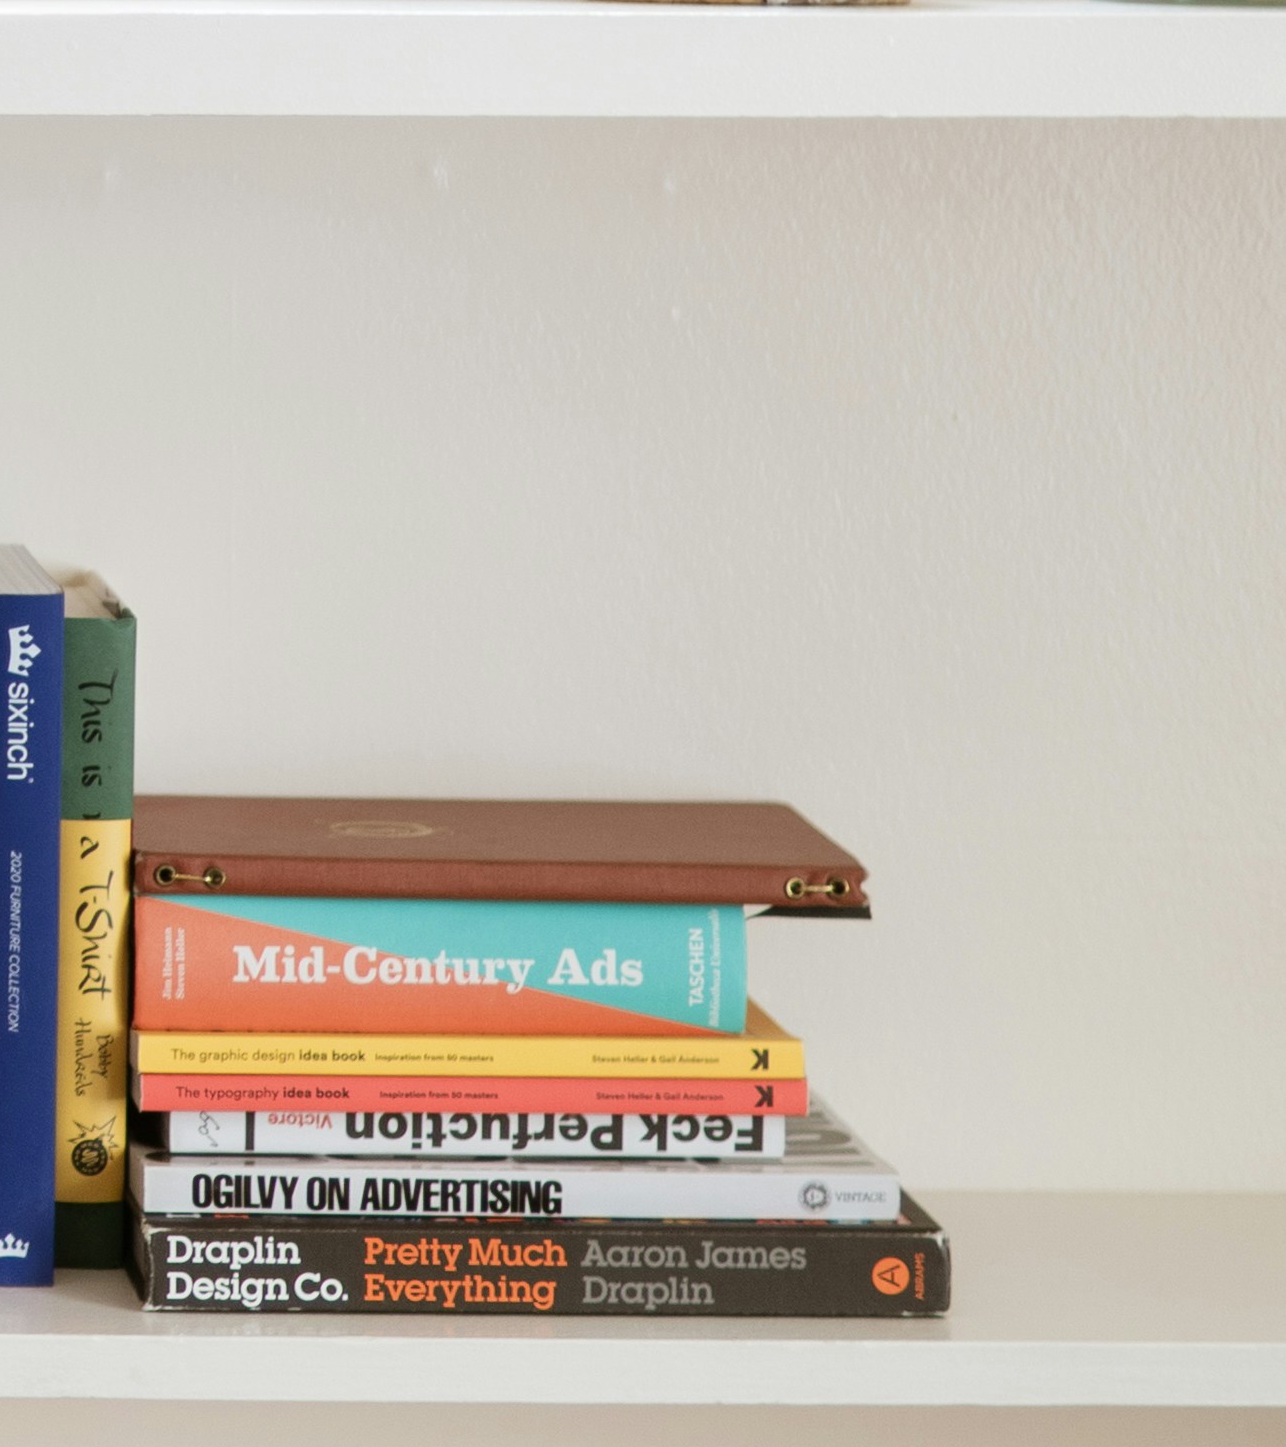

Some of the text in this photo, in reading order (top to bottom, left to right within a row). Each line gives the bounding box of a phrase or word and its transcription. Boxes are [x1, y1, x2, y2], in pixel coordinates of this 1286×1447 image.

[78, 670, 117, 744] This
[7, 681, 34, 780] sixinch
[82, 764, 102, 786] is
[7, 851, 22, 1032] 2020 FURNITURE COLLECTION
[232, 945, 644, 994] Mid-Century Ads
[689, 928, 703, 1007] TASCHEN
[172, 1049, 365, 1065] The graphic design idea book
[176, 1087, 498, 1103] The typography idea book Inspiration from 50 masters
[192, 1173, 562, 1215] OGILVY ON ADVERTISING
[835, 1191, 886, 1203] VINTAGE
[167, 1236, 301, 1269] Draplin
[365, 1238, 567, 1272] Pretty Much
[581, 1240, 806, 1269] Aaron James
[167, 1272, 348, 1307] Design Co.
[365, 1274, 556, 1310] Everything
[583, 1276, 714, 1310] Draplin
[915, 1253, 925, 1300] ABRAMS
